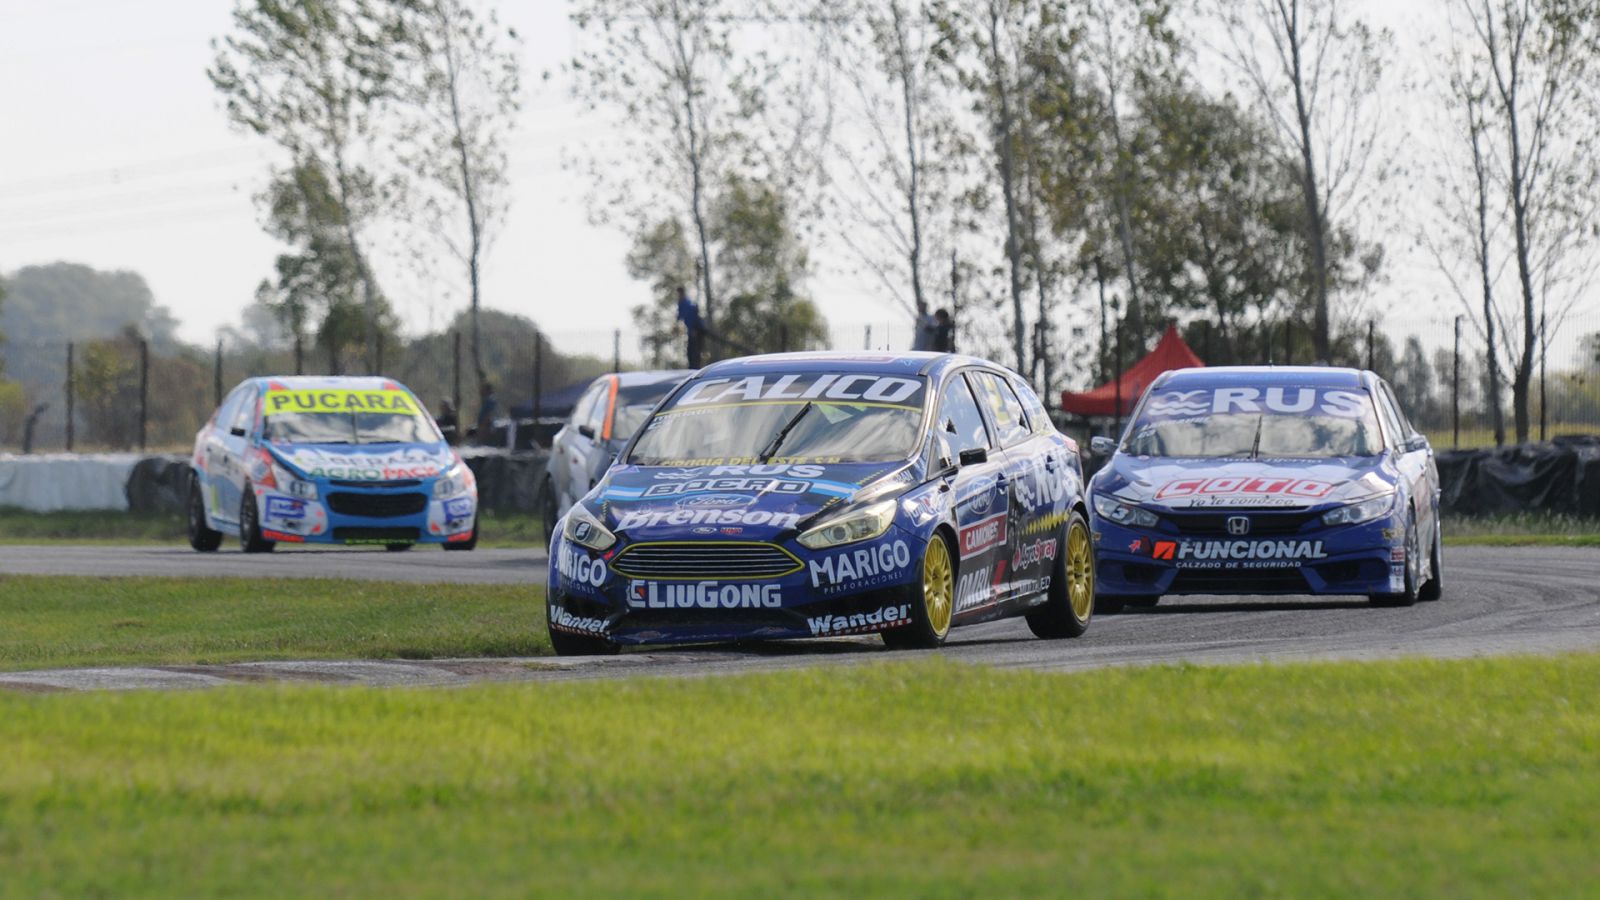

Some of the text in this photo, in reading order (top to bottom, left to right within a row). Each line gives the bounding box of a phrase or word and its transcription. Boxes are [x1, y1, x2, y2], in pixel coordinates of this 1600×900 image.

[272, 392, 412, 411] PUCARA
[677, 374, 922, 405] CALICO
[1212, 387, 1368, 418] RUS
[708, 464, 827, 478] RUS
[1153, 478, 1336, 501] COTO
[1189, 499, 1206, 507] Yo
[613, 508, 801, 533] Brenson
[1177, 540, 1328, 560] FUNCIONAL
[554, 543, 608, 588] RIGO
[808, 539, 911, 588] MARIGO
[1175, 561, 1302, 569] CALZADO DE SEGURIDAD
[823, 571, 904, 595] PERFORACIONES
[550, 604, 610, 633] Wander
[807, 603, 912, 635] Wander
